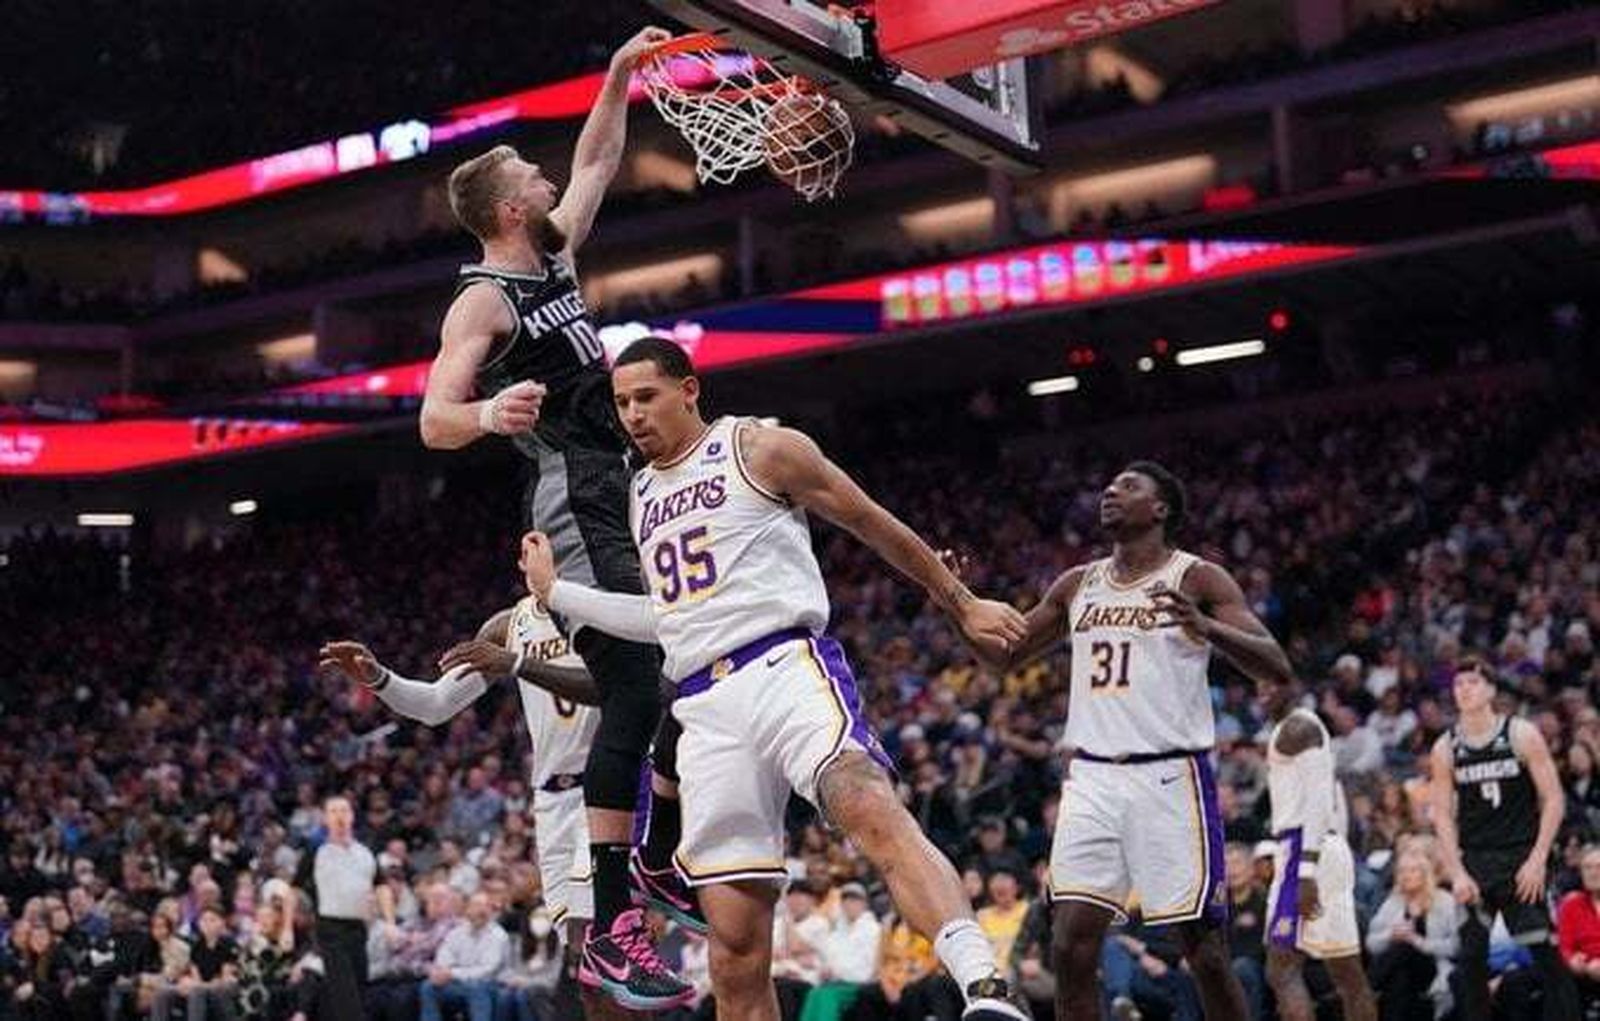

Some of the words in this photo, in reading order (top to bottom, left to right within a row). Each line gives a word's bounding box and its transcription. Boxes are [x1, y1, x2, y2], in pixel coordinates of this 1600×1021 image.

[522, 291, 586, 339] KING
[562, 319, 604, 365] 10
[639, 475, 727, 545] LAKERS
[654, 526, 717, 602] 95
[1074, 601, 1158, 632] LAKERS
[1091, 641, 1131, 688] 31
[1481, 781, 1501, 809] 9
